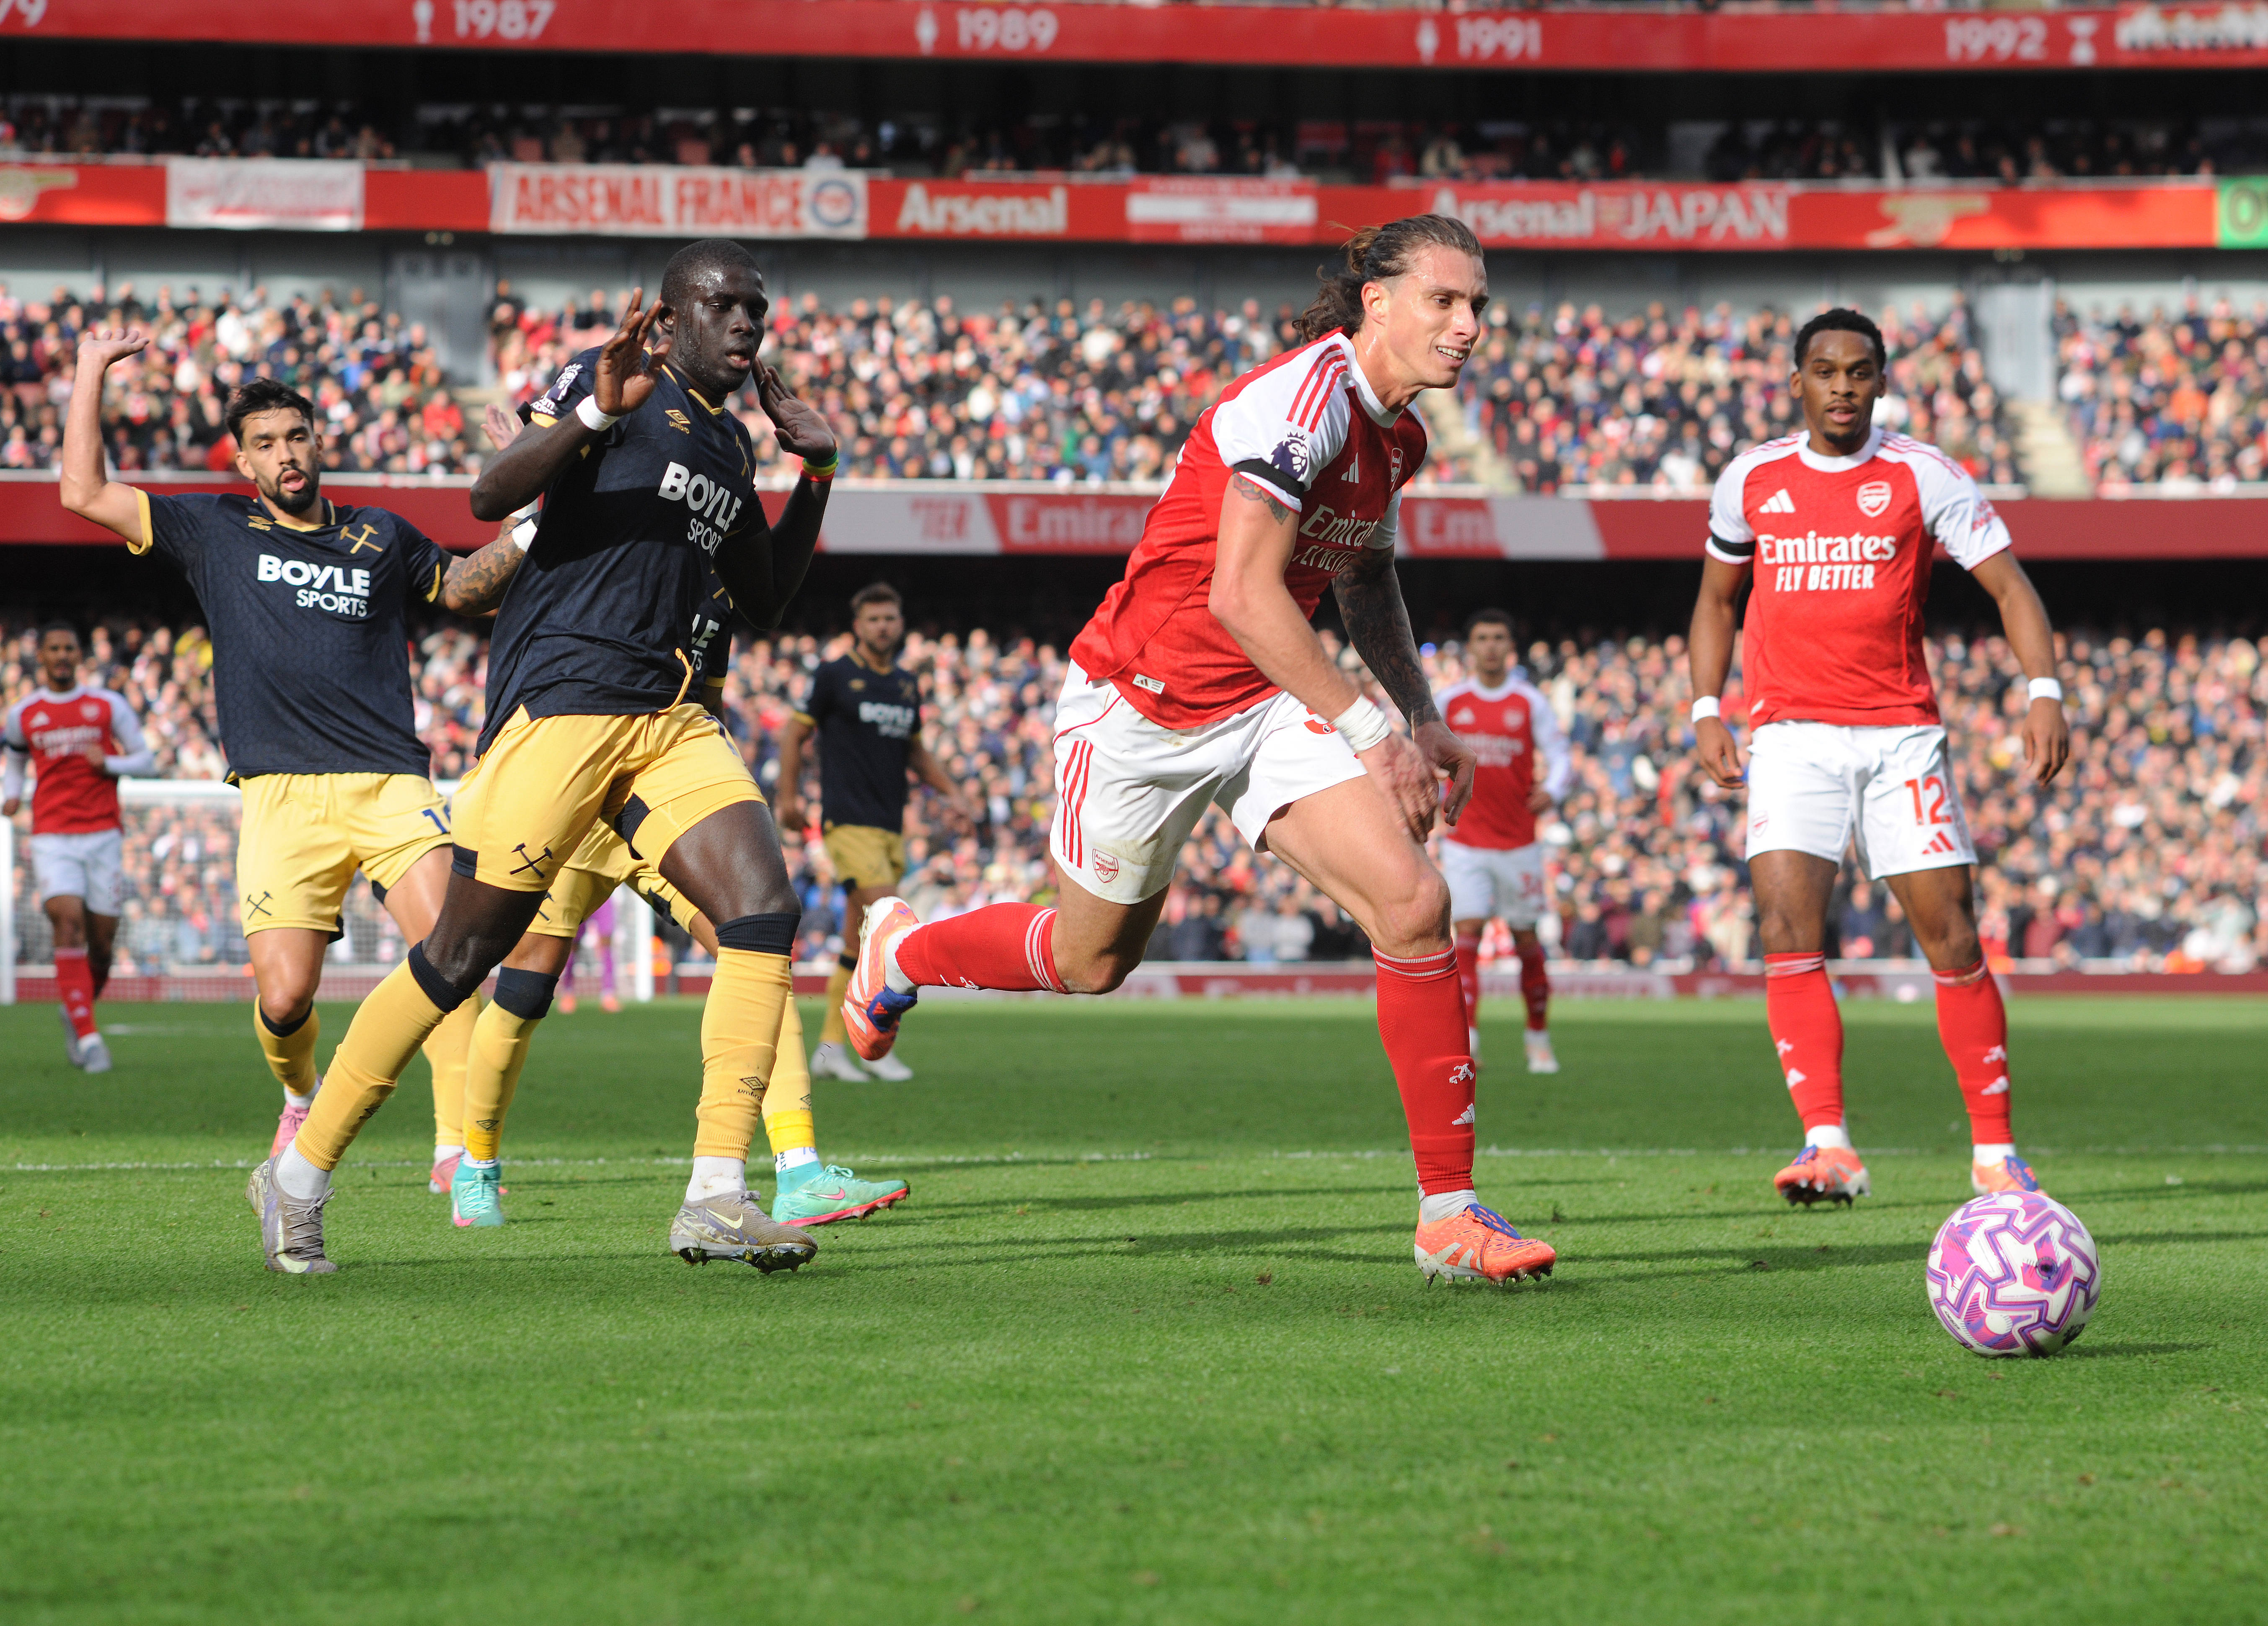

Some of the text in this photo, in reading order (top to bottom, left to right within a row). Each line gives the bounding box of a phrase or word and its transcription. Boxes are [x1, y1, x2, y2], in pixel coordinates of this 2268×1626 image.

[454, 1, 555, 39] 1987
[958, 10, 1059, 51] 1989
[1456, 18, 1542, 59] 1991
[1945, 18, 2048, 60] 1992
[514, 174, 665, 225] ARSENAL
[675, 177, 802, 229] FRANCE
[897, 184, 1068, 235] Arsenal
[1621, 190, 1788, 241] JAPAN
[669, 421, 690, 434] umbro
[657, 461, 742, 532] BOYLE
[688, 518, 722, 558] SPORT
[1009, 497, 1146, 546] Emira
[1758, 531, 1897, 565] Emirates
[257, 554, 370, 597] BOYLE
[1775, 564, 1875, 592] FLY BETTER
[296, 589, 367, 617] SPORTS
[1904, 775, 1952, 826] 12
[738, 1089, 761, 1100] umbro
